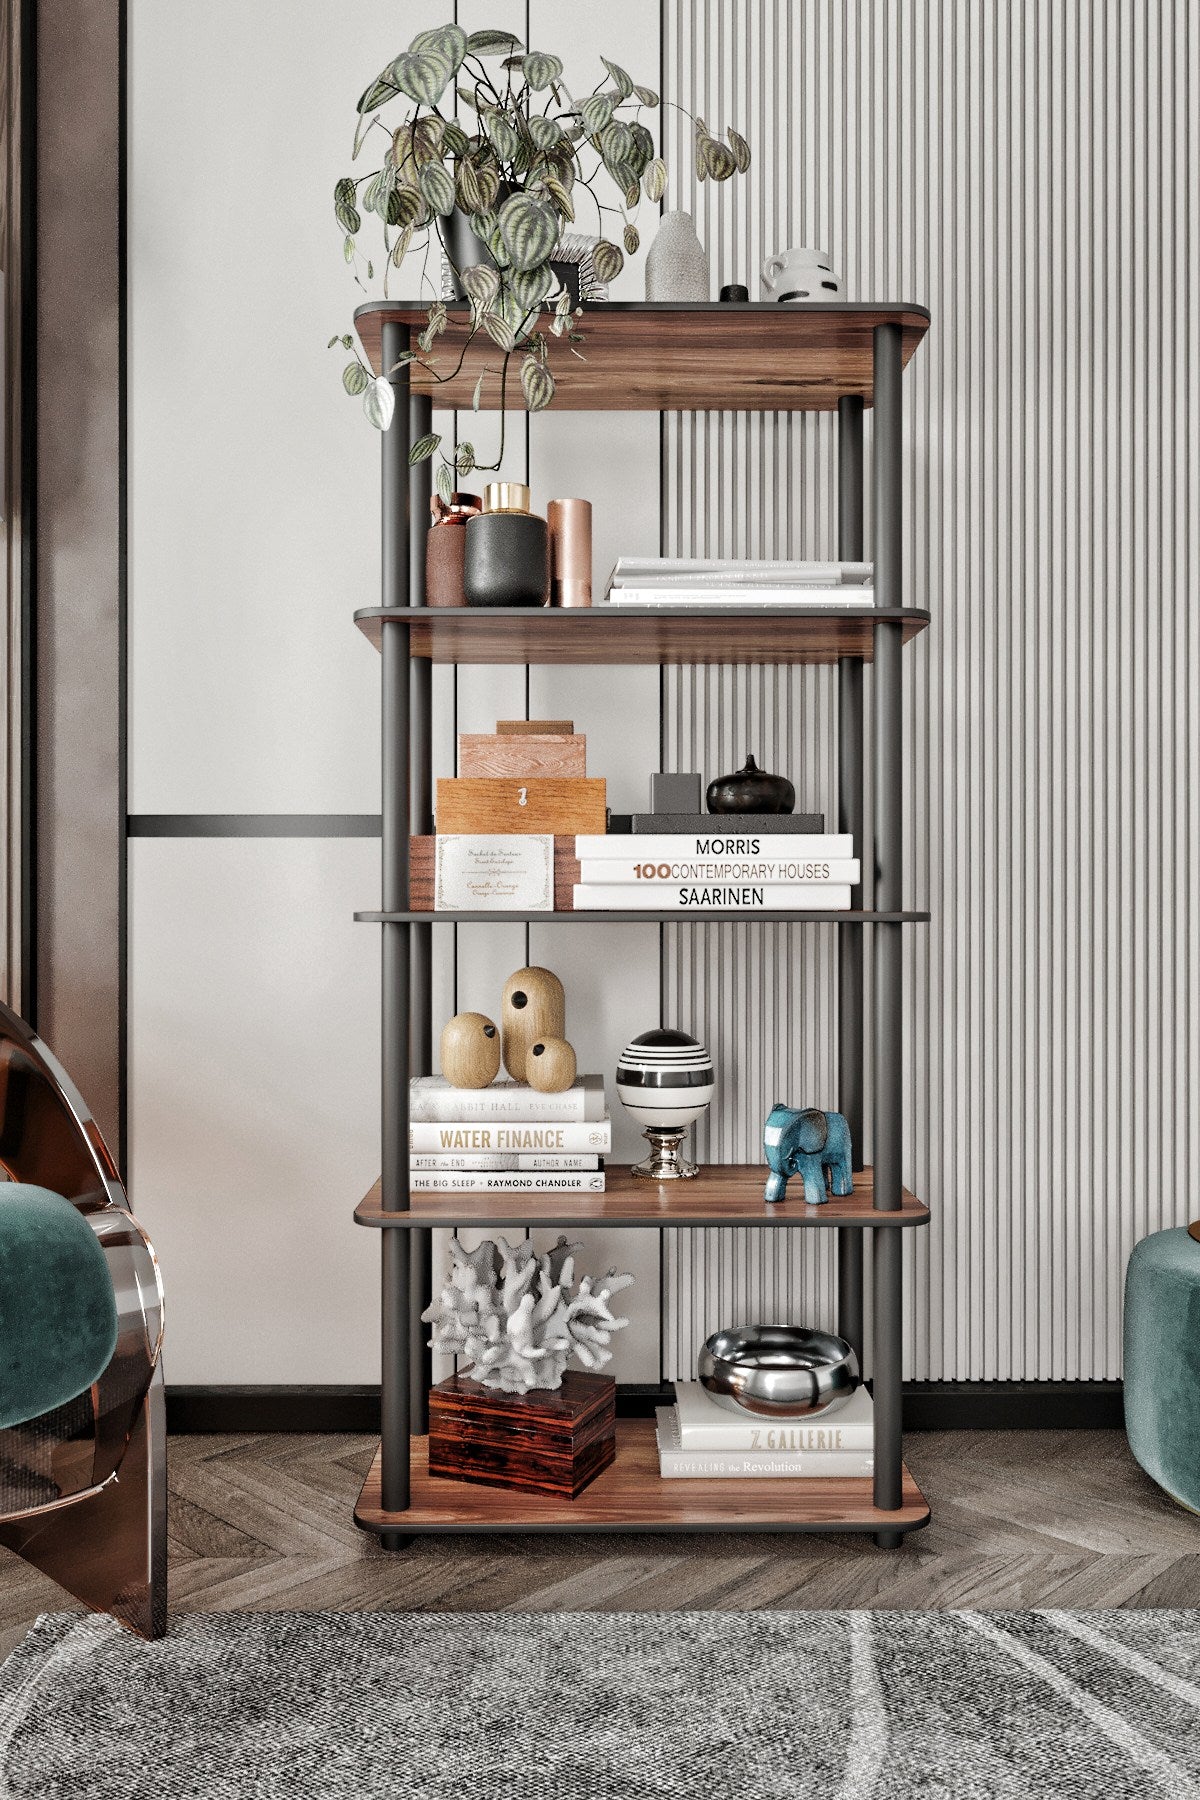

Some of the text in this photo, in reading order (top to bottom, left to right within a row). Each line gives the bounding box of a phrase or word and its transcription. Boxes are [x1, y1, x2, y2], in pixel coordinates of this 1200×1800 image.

[696, 839, 761, 855] MORRIS
[778, 864, 830, 879] HOUSES
[679, 888, 764, 905] SAARINEN
[491, 1103, 521, 1111] HALL
[440, 1130, 564, 1148] WATER FINANCE
[416, 1159, 437, 1167] AFTER
[451, 1159, 465, 1167] END
[533, 1159, 559, 1167] AUTHOR
[564, 1159, 583, 1167] NAME
[415, 1179, 582, 1187] THE BIG SLEEP RAYMOND CHANDLER
[673, 1461, 802, 1473] REVEALING the Revolution
